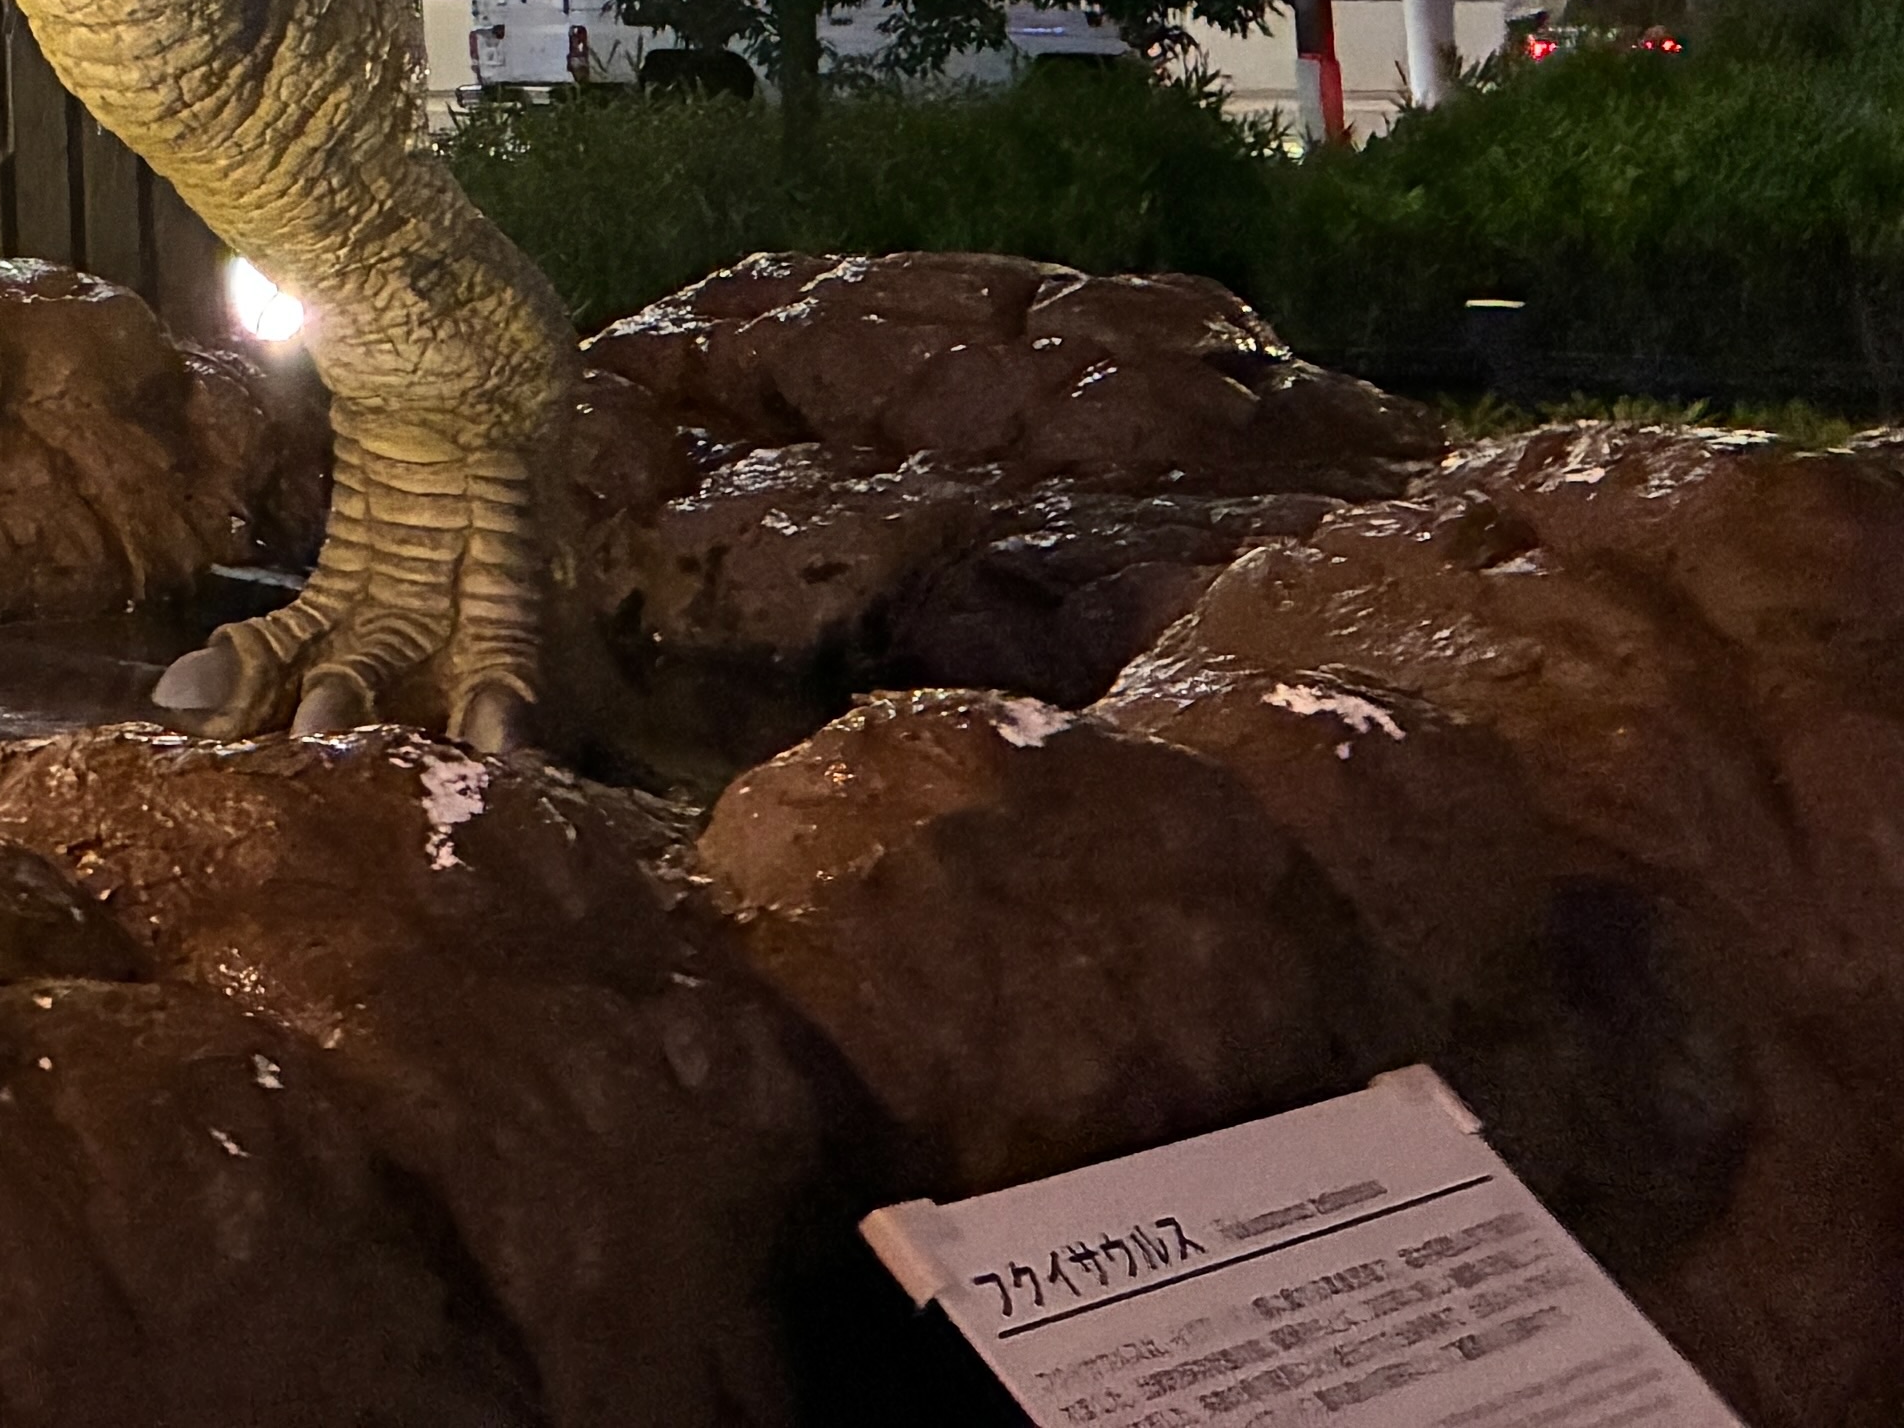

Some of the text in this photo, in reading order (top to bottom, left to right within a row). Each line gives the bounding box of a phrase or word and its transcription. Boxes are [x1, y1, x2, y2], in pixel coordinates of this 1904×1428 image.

[973, 1217, 1206, 1317] フクイサウルス
